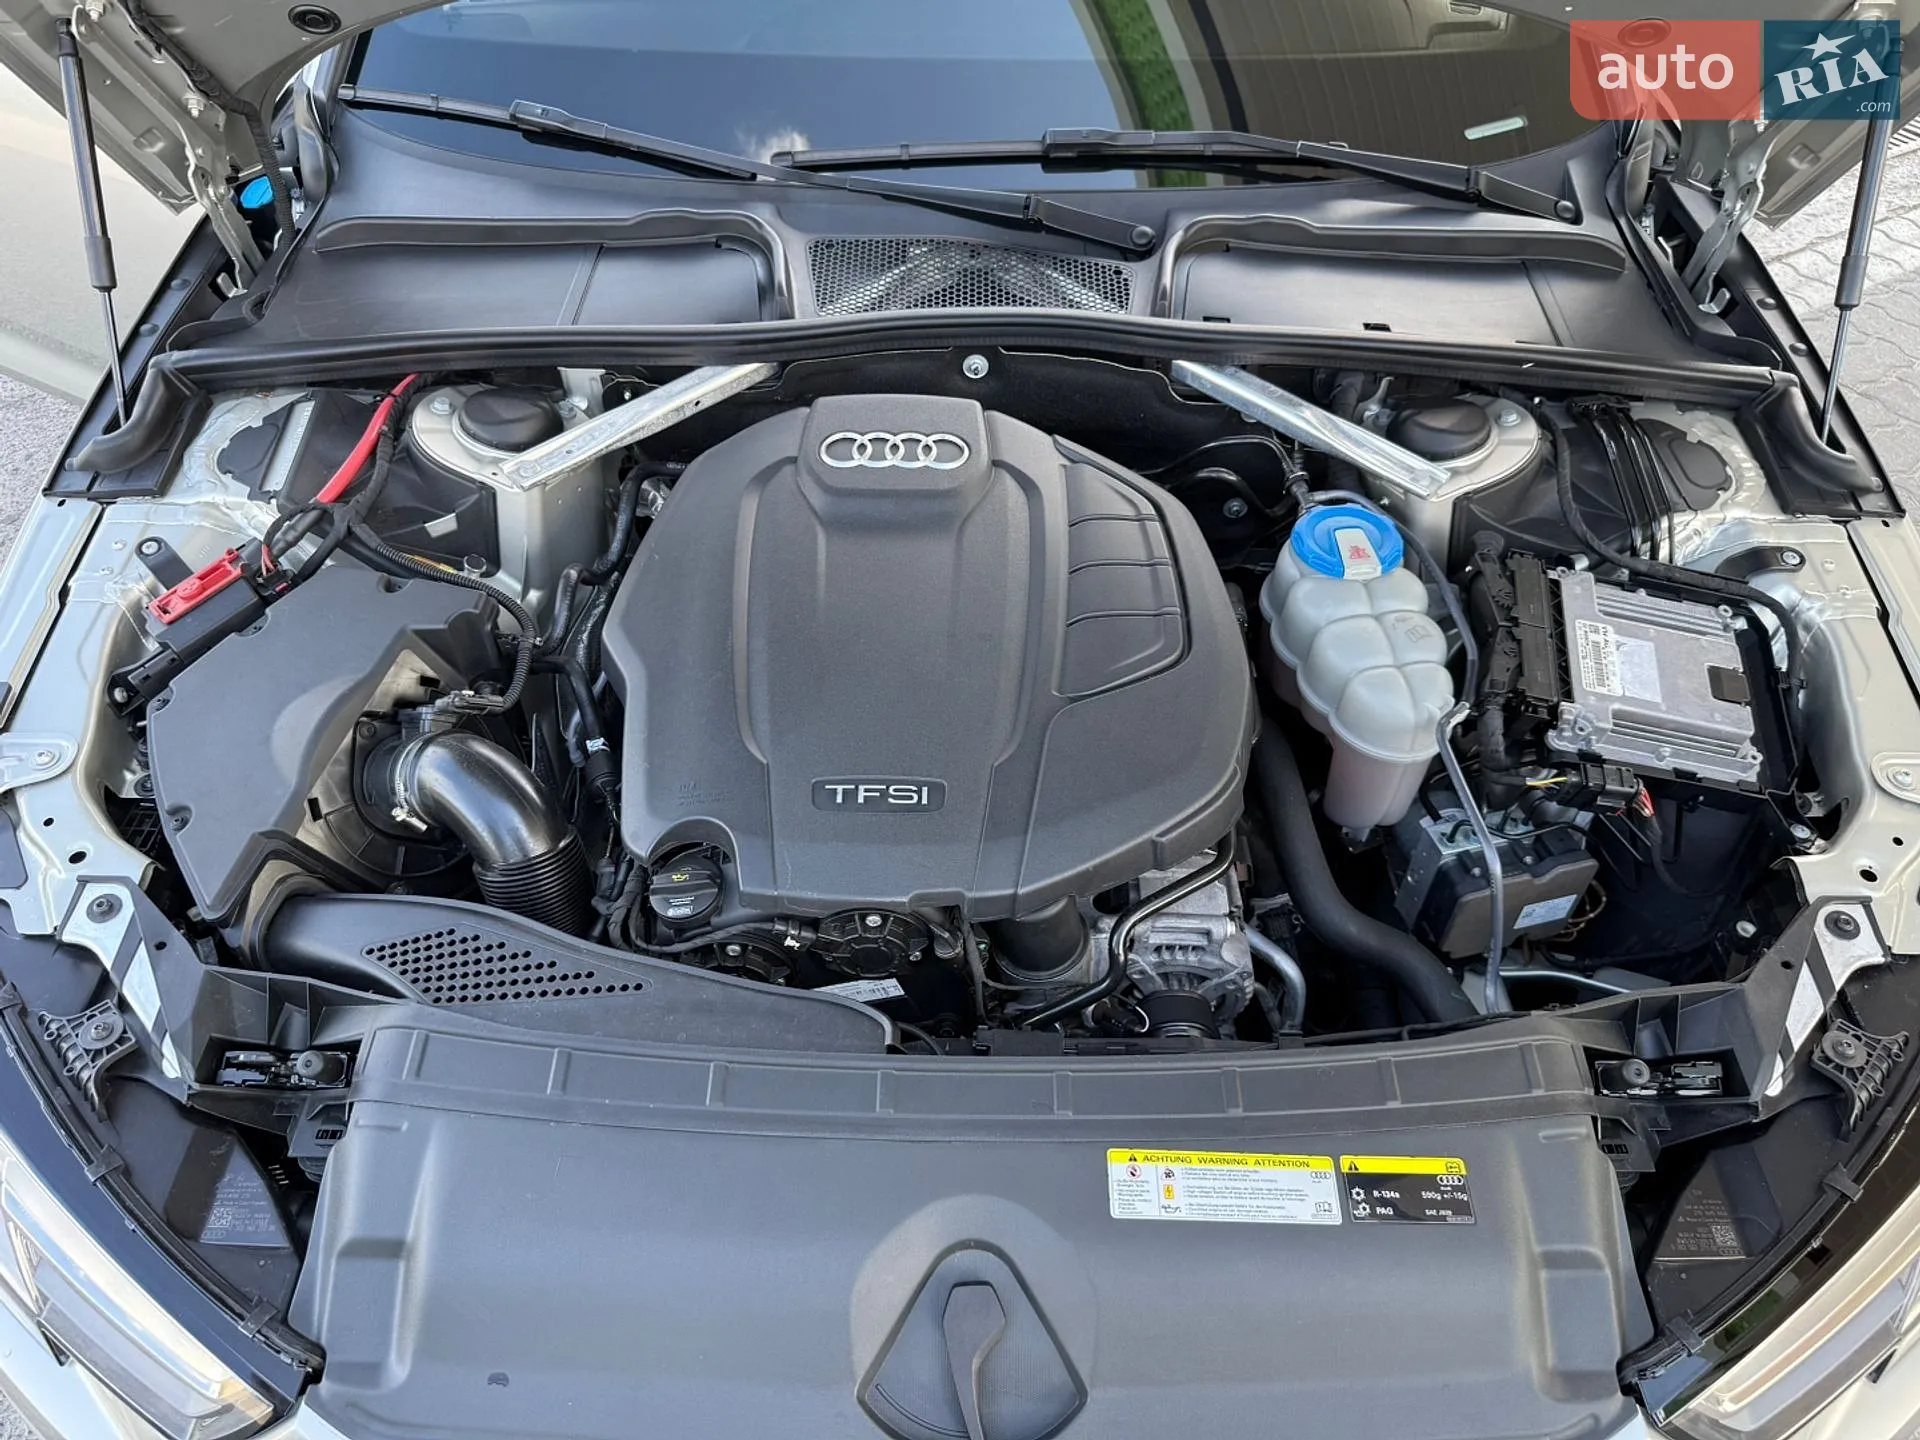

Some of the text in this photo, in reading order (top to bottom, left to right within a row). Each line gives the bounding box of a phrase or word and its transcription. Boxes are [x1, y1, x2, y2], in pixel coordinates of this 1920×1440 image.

[824, 784, 929, 805] TFSI
[1142, 1154, 1310, 1168] ACHTUNG WARNING ATTENTION
